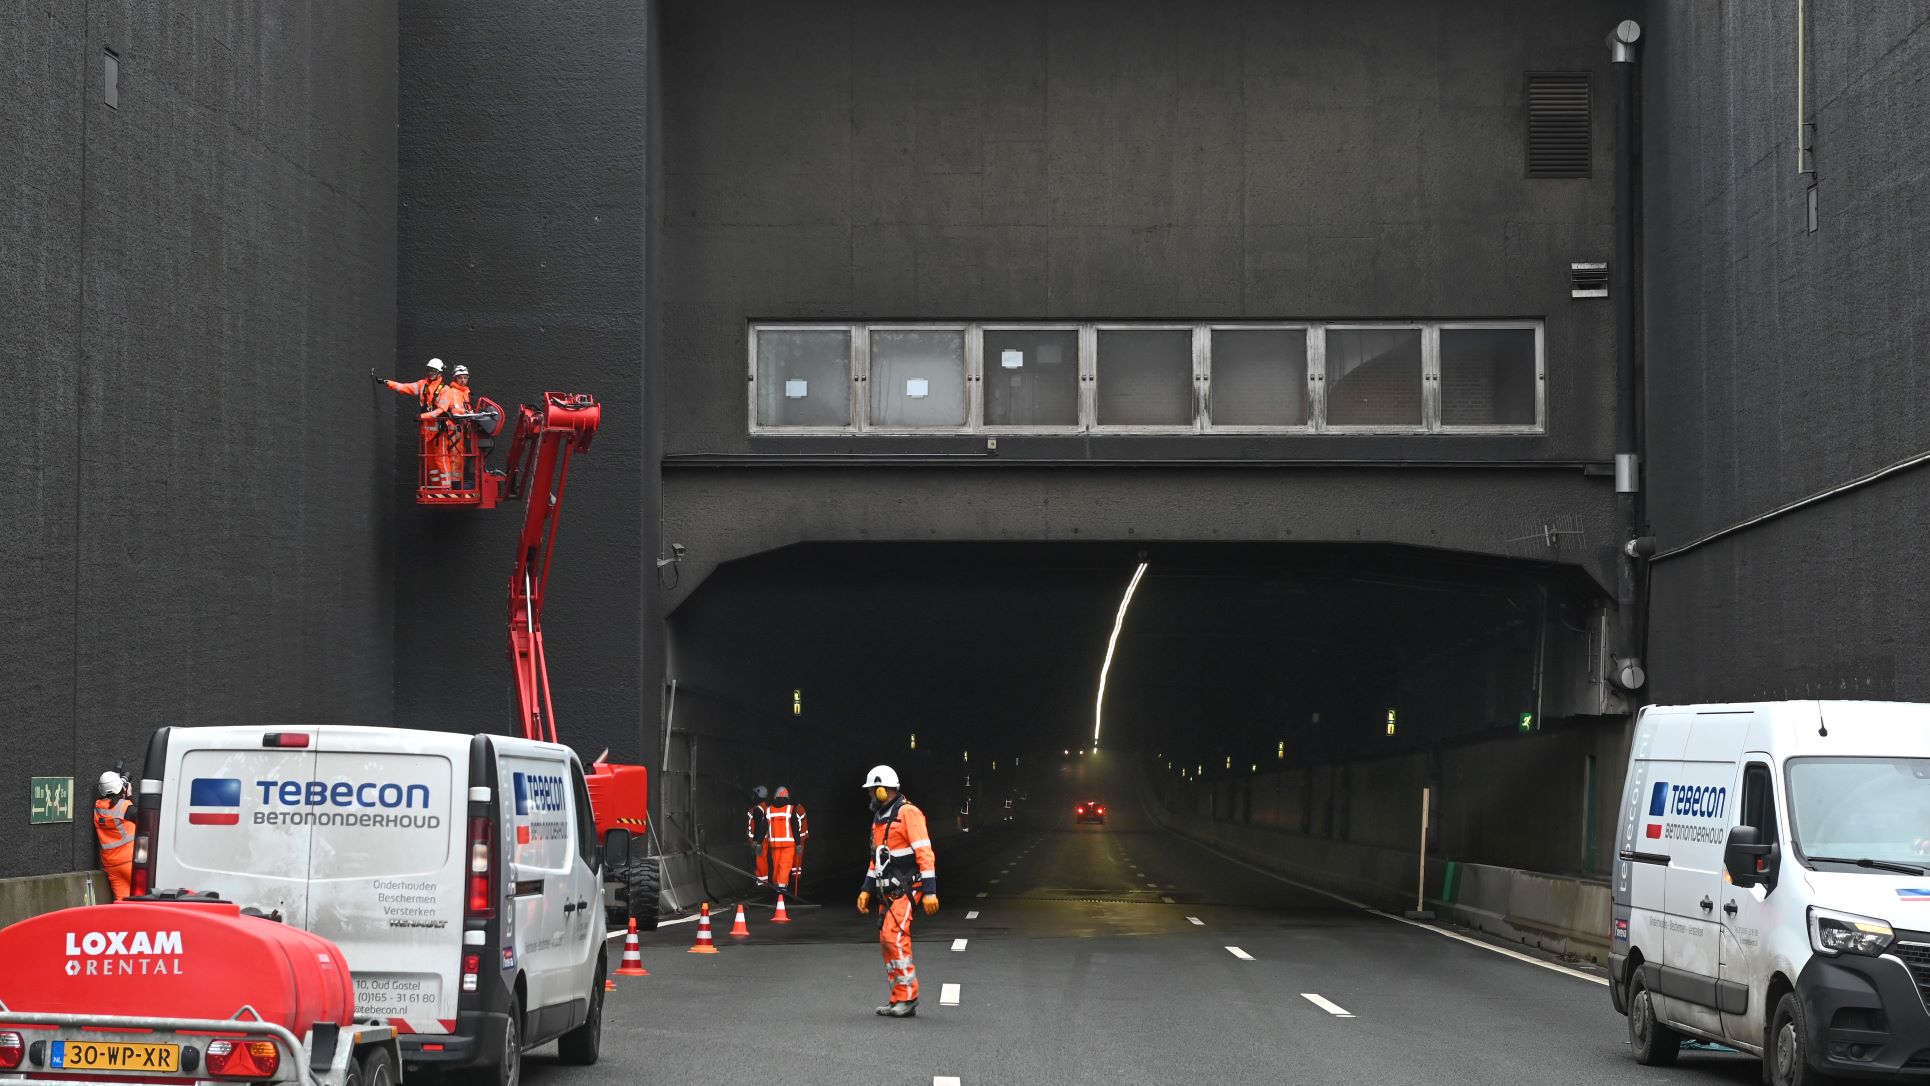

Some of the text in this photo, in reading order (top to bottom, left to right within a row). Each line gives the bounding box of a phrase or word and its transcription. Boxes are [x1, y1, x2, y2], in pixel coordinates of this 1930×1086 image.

[373, 879, 437, 891] Onderhouden
[378, 892, 436, 904] Beschermen
[383, 905, 436, 917] Versterken
[389, 919, 448, 929] RENAULT
[65, 931, 184, 956] LOXAM
[86, 959, 183, 975] RENTAL
[371, 980, 390, 990] Oud
[358, 992, 387, 1003] (0)165
[396, 993, 406, 1002] 31
[409, 993, 420, 1003] 61
[422, 993, 436, 1003] 80
[53, 1056, 62, 1064] NL
[70, 1045, 171, 1067] 30-WP-XR
